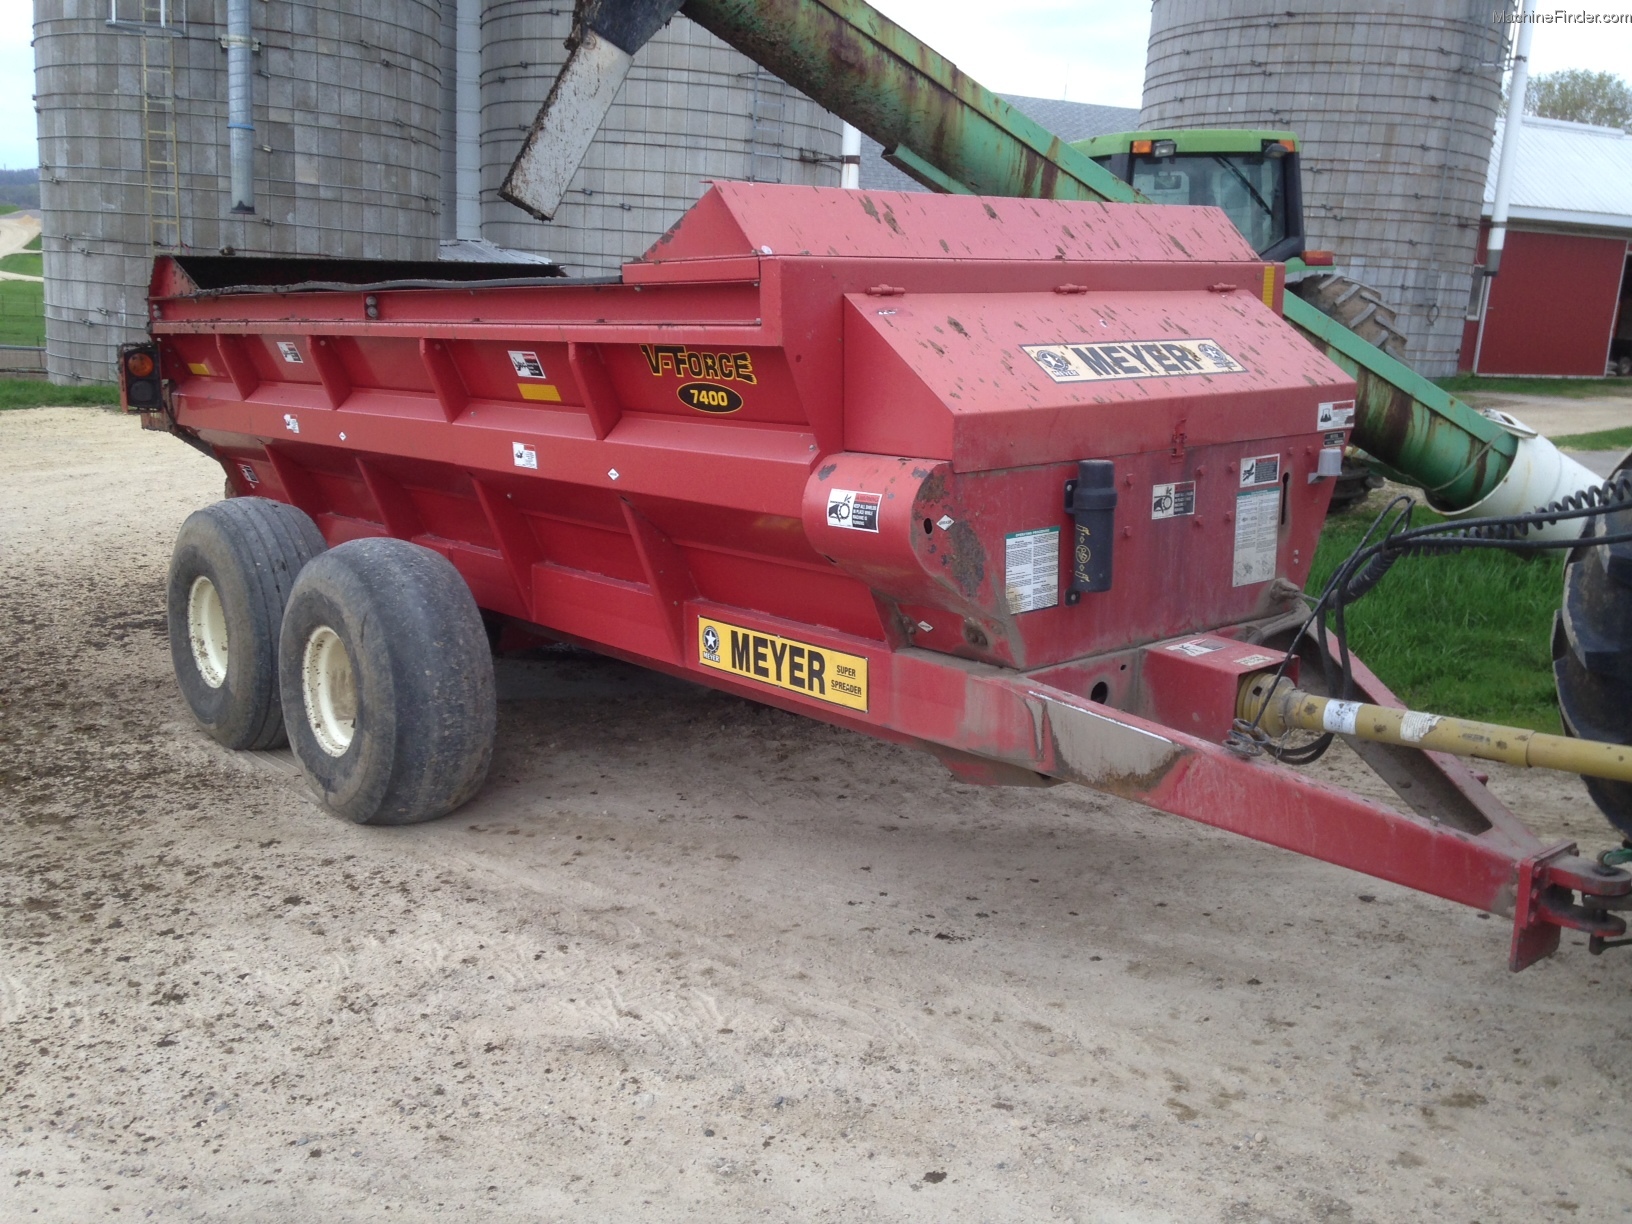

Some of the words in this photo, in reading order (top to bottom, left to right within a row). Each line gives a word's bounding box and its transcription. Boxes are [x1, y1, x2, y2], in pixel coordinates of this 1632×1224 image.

[639, 343, 757, 385] V-FORCE
[1071, 343, 1204, 376] MEYER
[689, 389, 728, 407] 7400
[703, 651, 721, 664] MEYER
[730, 629, 826, 696] MEYER
[836, 664, 856, 678] SUPER
[830, 679, 862, 696] SPREADER
